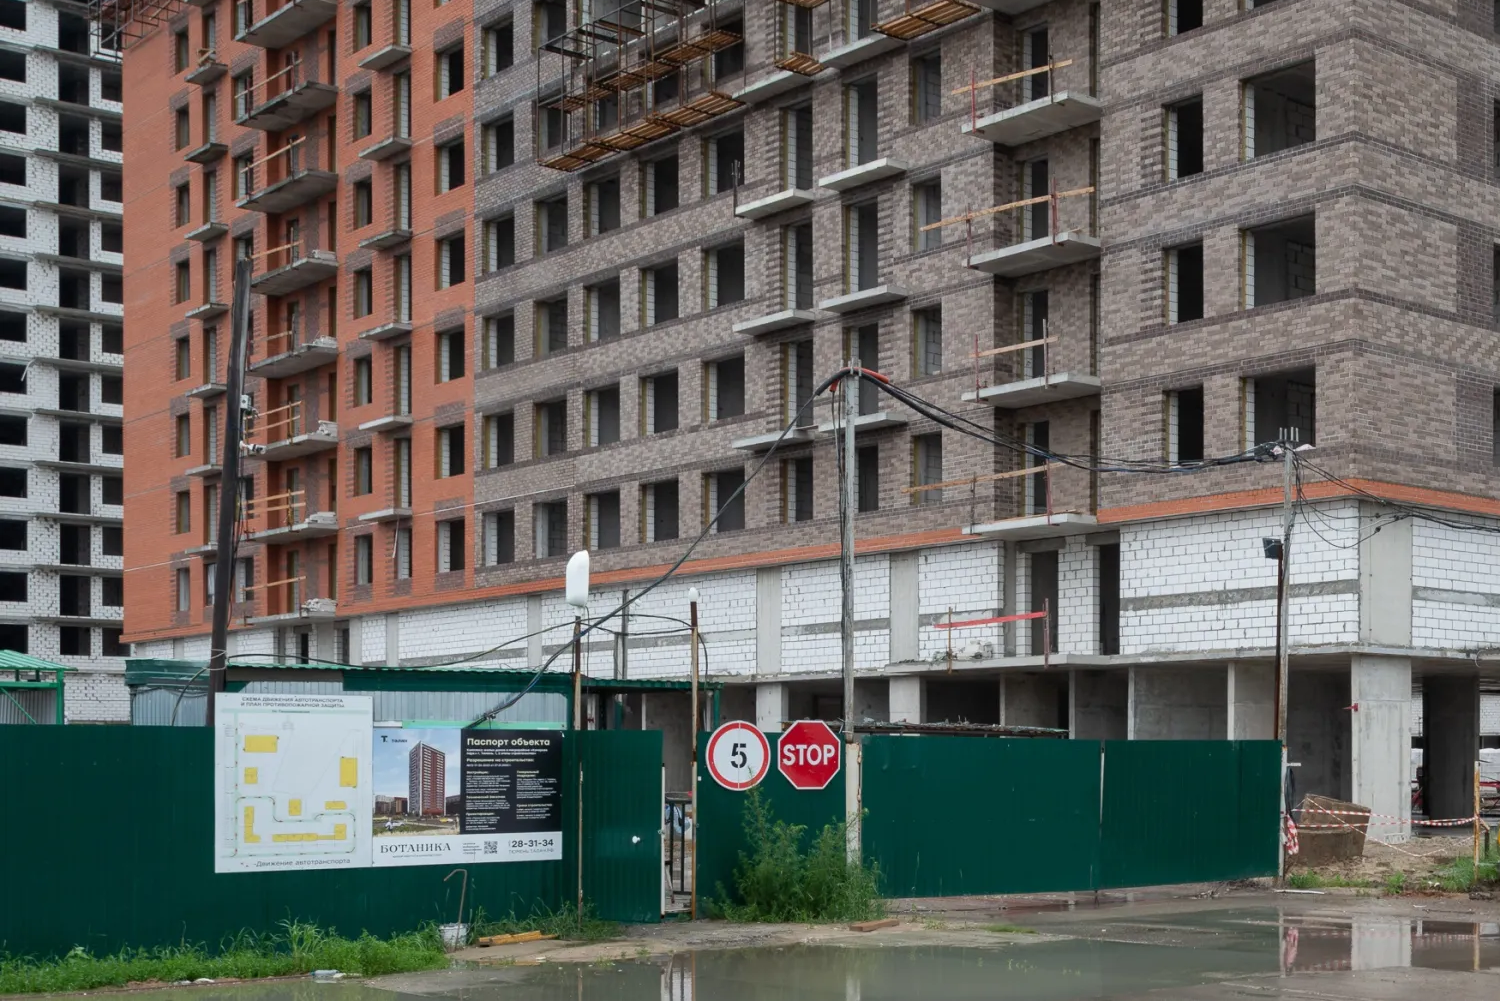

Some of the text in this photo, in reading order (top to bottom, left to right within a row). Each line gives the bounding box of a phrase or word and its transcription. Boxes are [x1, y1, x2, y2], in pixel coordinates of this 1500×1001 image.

[467, 738, 550, 747] Паспорт объекта
[731, 743, 747, 768] 5
[782, 744, 835, 766] STOP
[380, 843, 451, 853] БОТАНИКА
[511, 839, 554, 848] 28-31-34
[295, 858, 351, 866] автотранспорта
